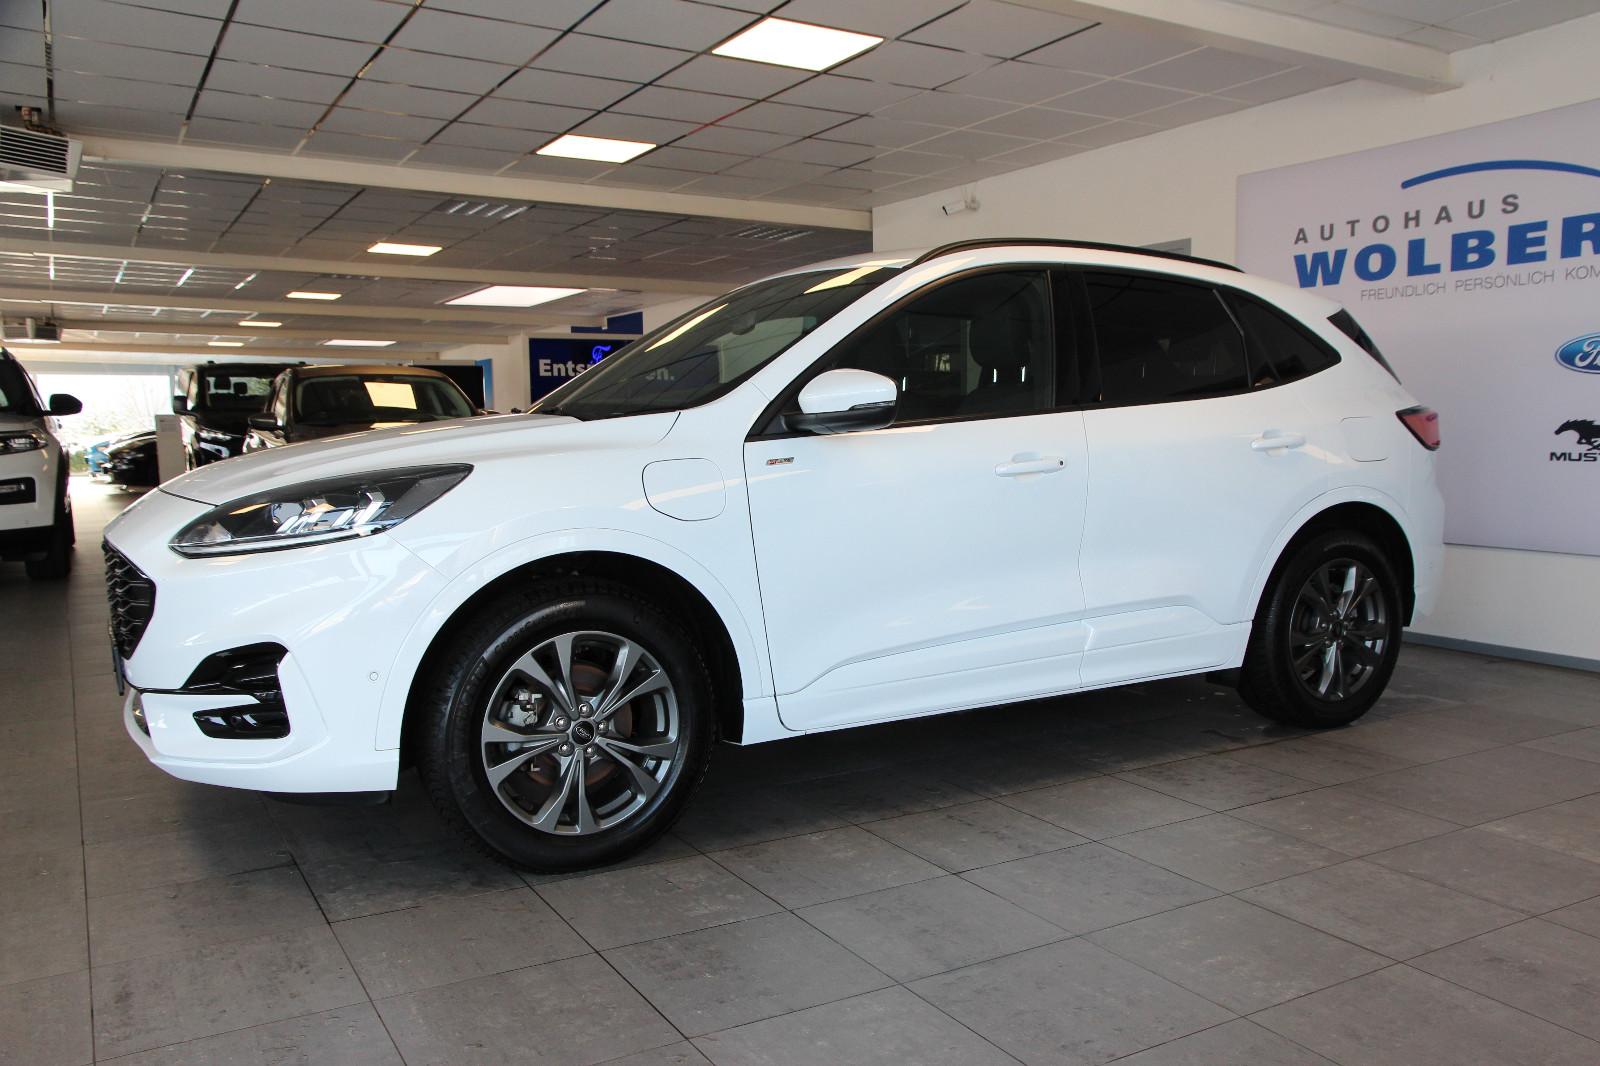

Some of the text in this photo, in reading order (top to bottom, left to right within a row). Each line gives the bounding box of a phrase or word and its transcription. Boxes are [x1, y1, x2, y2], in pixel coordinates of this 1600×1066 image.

[1294, 194, 1520, 244] AUTOHAUS
[1293, 212, 1600, 288] WOLBER
[1360, 281, 1446, 301] FREUNDLICH
[1550, 452, 1600, 462] MUS
